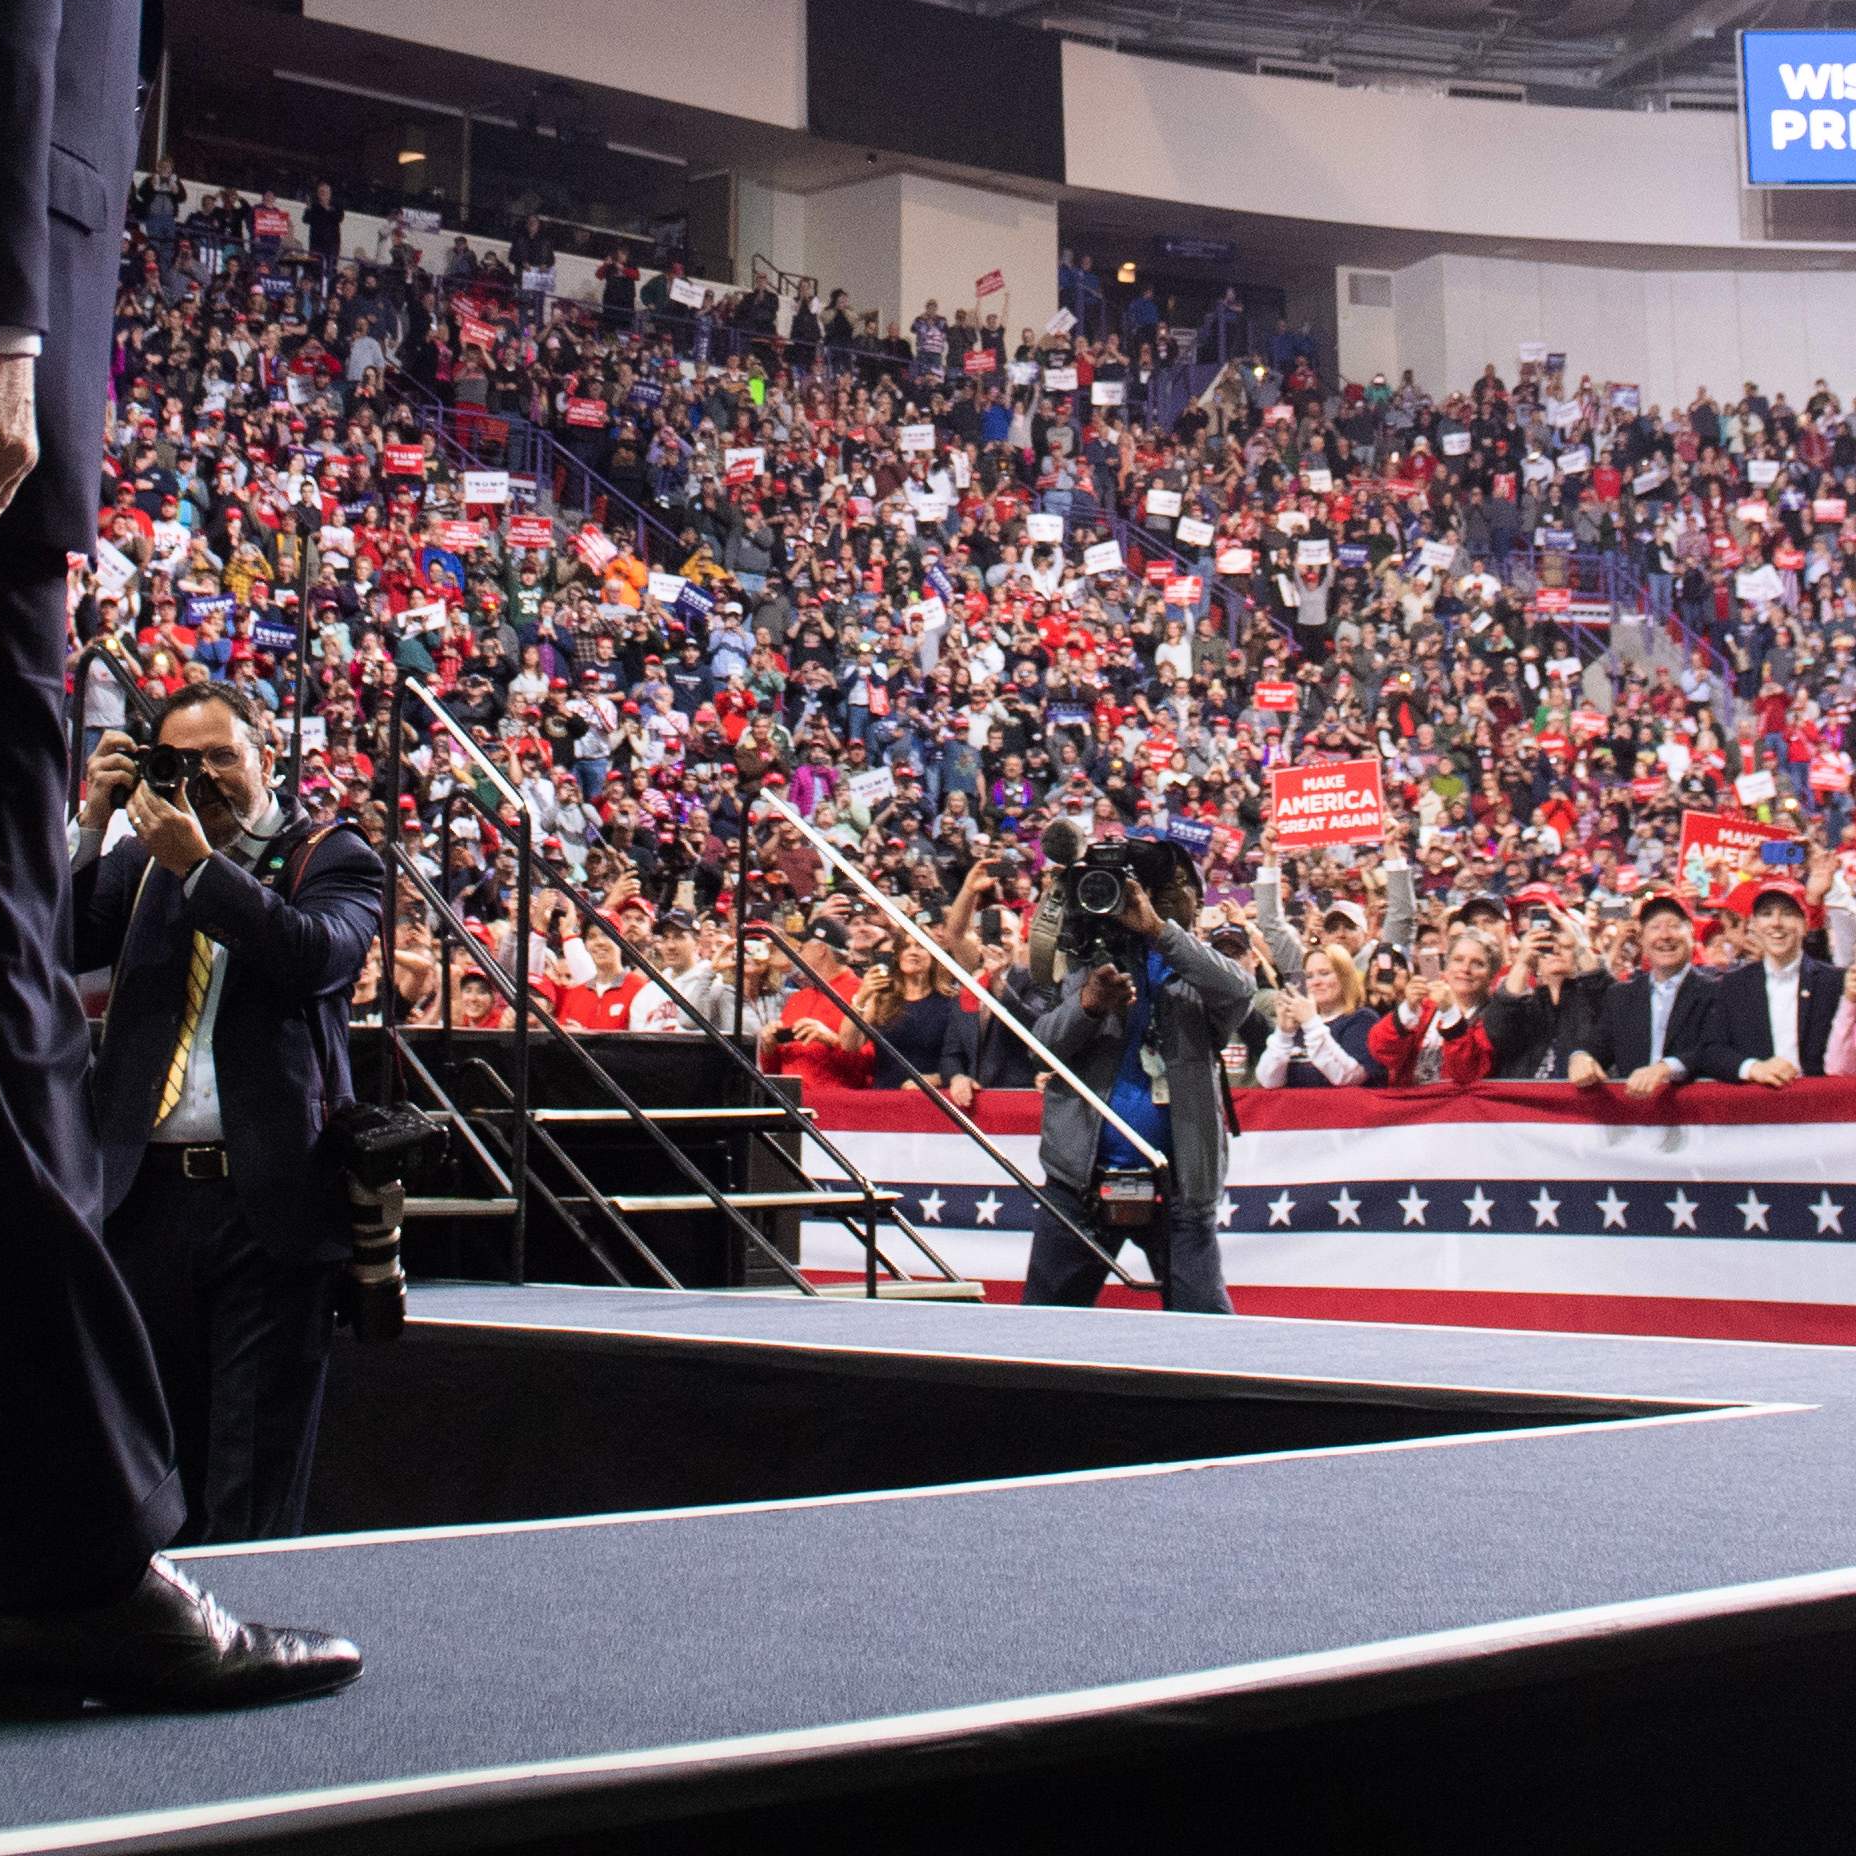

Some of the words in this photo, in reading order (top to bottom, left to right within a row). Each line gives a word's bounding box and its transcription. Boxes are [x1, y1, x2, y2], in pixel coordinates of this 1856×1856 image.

[1302, 773, 1346, 792] MAKE
[1277, 789, 1377, 817] AMERICA
[1278, 816, 1325, 834] GREAT
[1329, 811, 1380, 829] AGAIN
